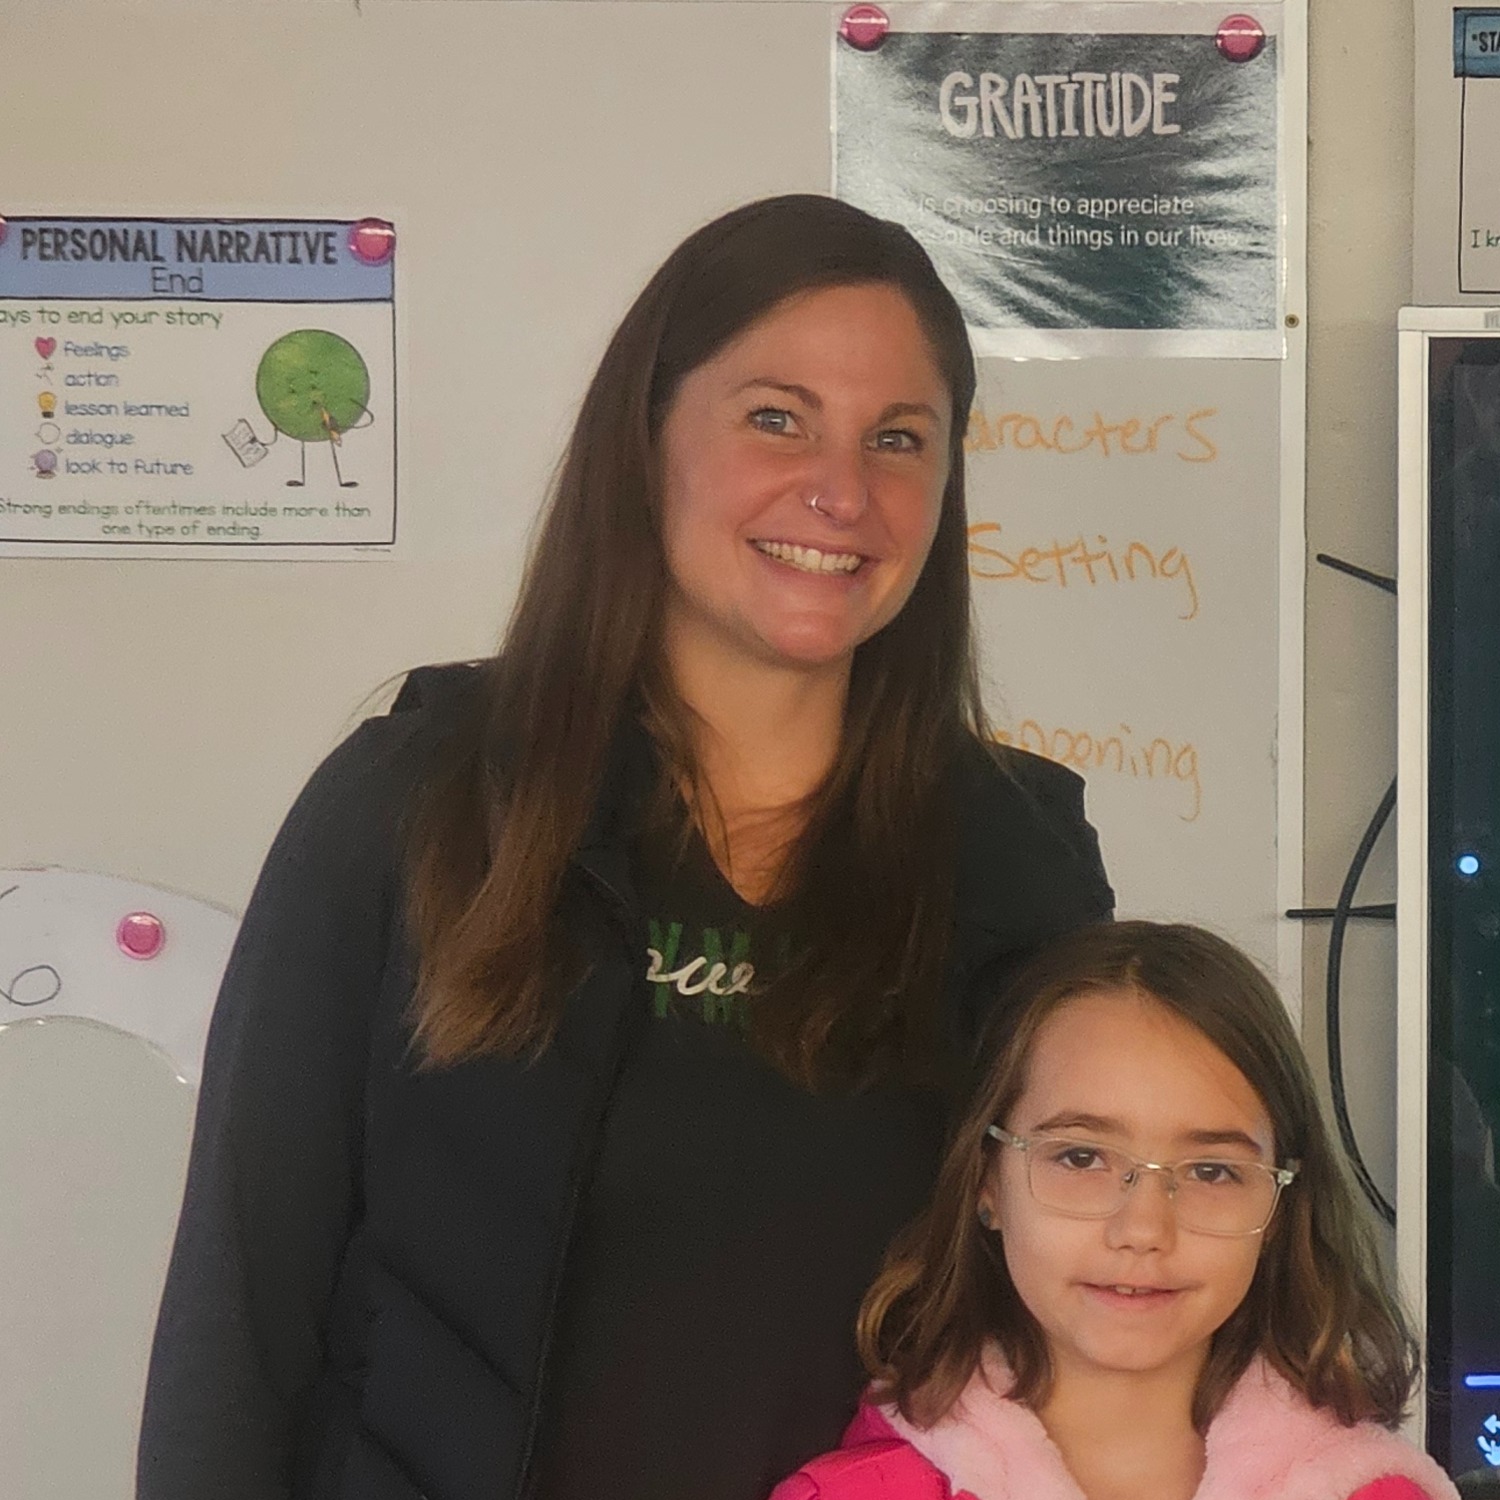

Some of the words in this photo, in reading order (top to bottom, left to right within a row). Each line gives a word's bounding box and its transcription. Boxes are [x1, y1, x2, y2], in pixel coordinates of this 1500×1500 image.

[939, 71, 1181, 139] GRATITUDE
[1050, 196, 1070, 213] to
[1078, 196, 1194, 219] appreciate
[21, 228, 164, 263] PERSONAL
[177, 231, 338, 264] NARRATIVE
[1000, 227, 1039, 246] and
[1048, 225, 1112, 250] things
[1121, 226, 1139, 246] in
[1146, 230, 1180, 246] our
[1471, 230, 1481, 248] I
[152, 267, 203, 294] End
[0, 309, 31, 326] ays
[965, 409, 1217, 463] aracters
[967, 522, 1199, 620] Setting
